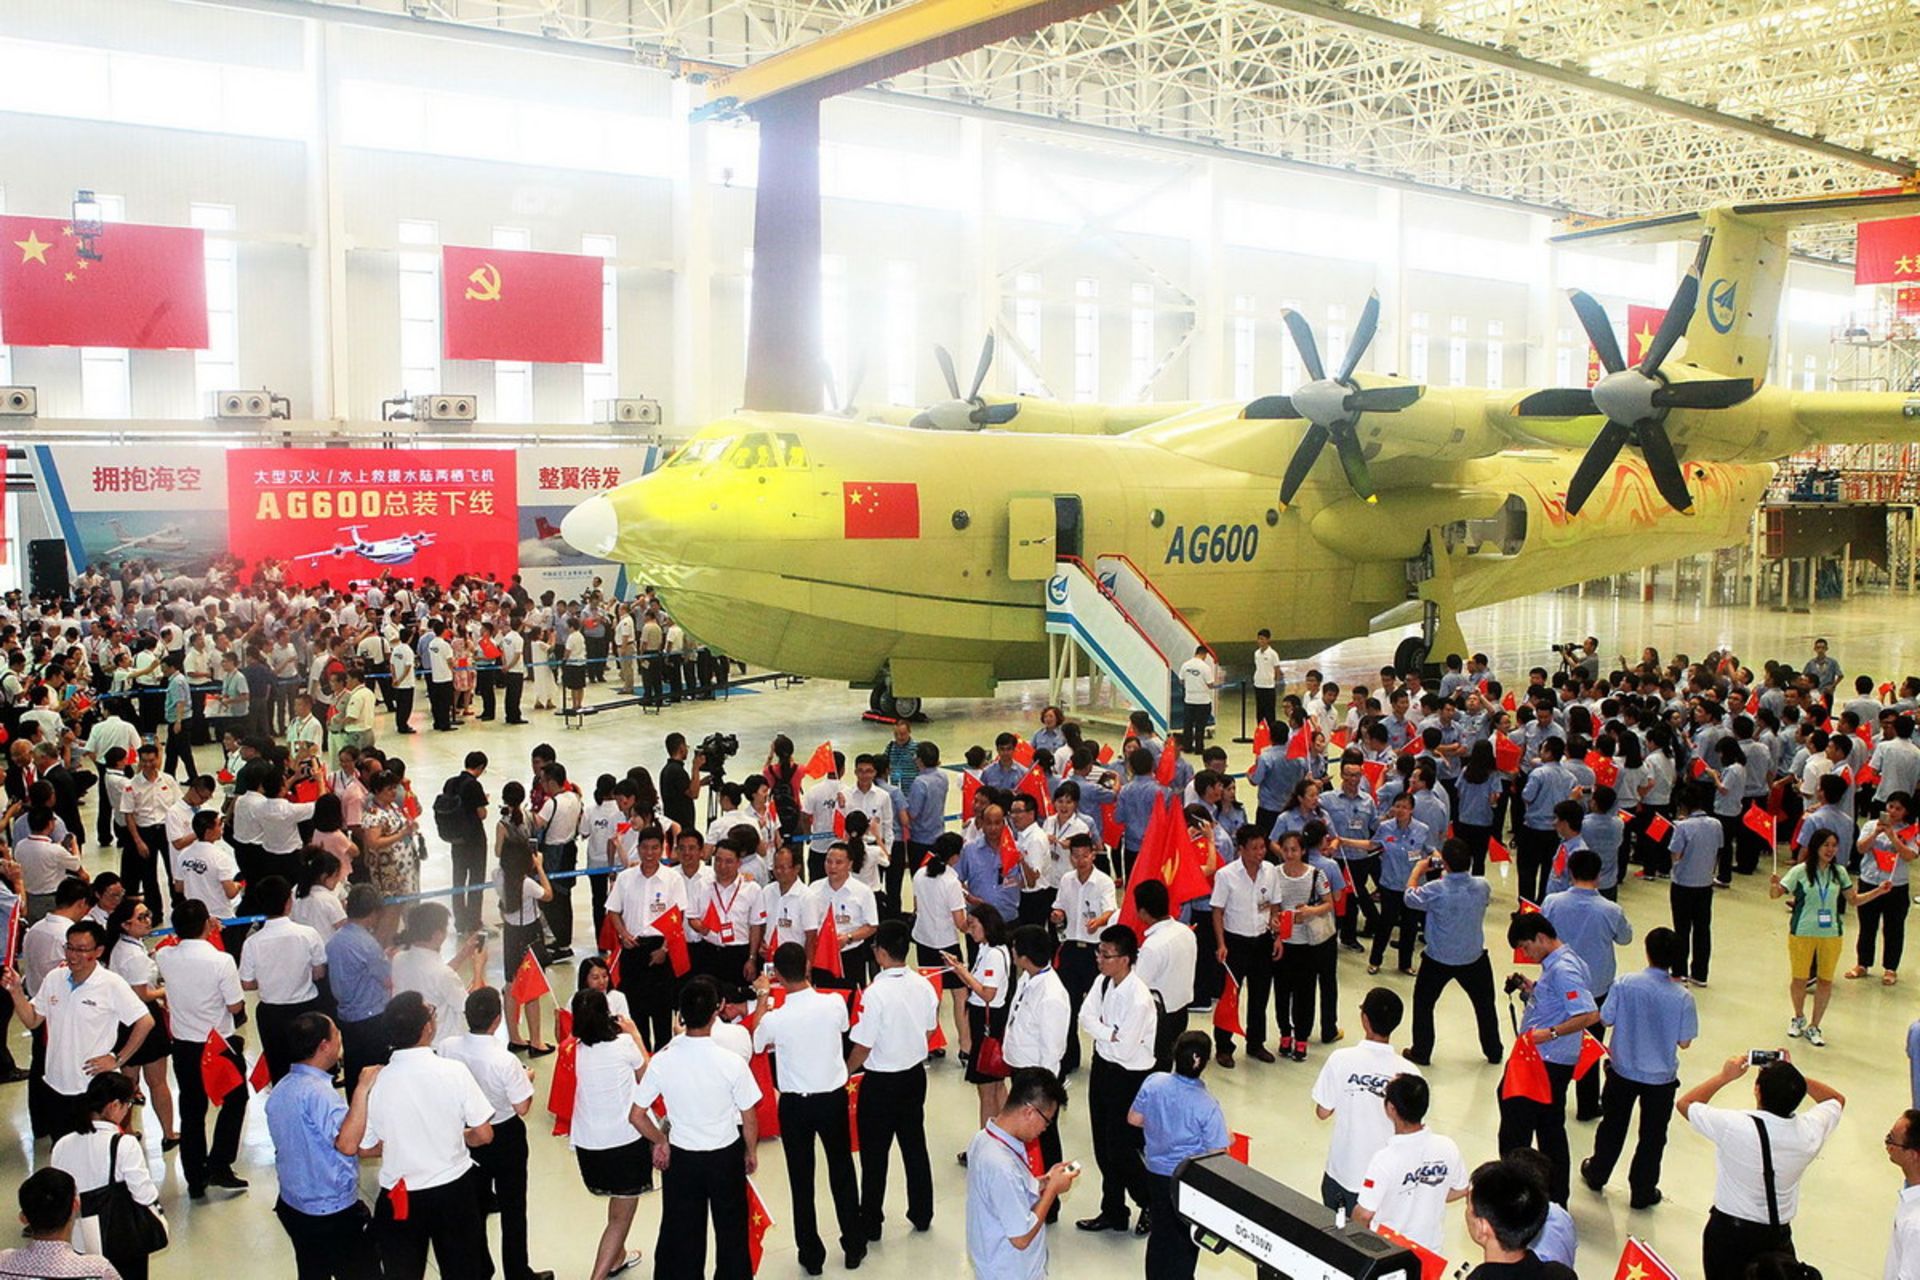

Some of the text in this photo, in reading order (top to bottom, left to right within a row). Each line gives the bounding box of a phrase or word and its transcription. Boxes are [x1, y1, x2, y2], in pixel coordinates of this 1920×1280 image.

[92, 466, 202, 492] 拥抱海空
[538, 466, 621, 490] 整翼待发
[1165, 524, 1260, 564] AG600
